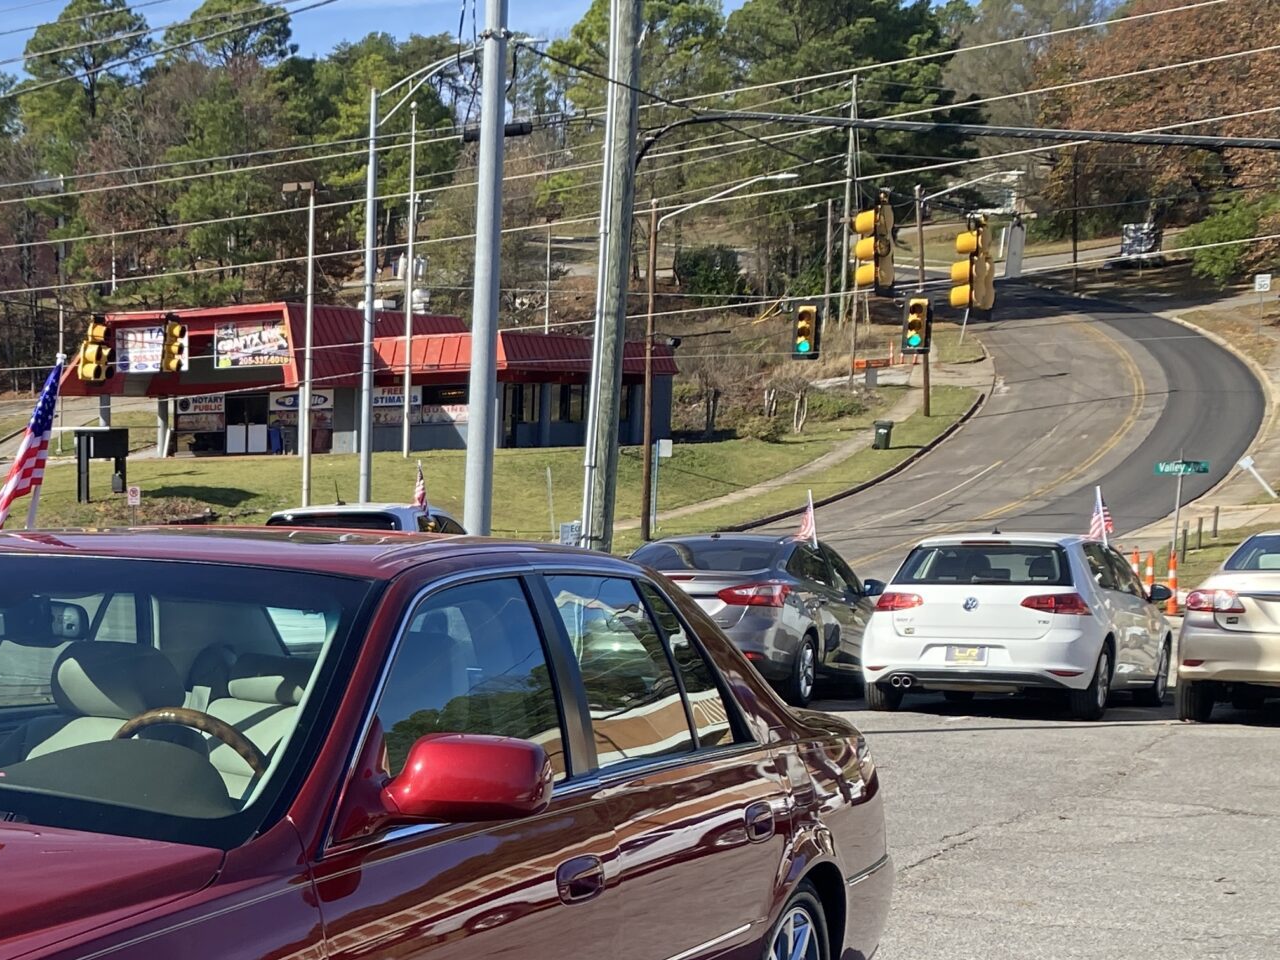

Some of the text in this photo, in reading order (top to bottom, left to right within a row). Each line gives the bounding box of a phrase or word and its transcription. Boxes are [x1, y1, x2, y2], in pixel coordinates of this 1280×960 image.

[191, 396, 224, 404] NOTARY
[193, 404, 223, 412] PUBLIC
[1159, 462, 1186, 475] Valley
